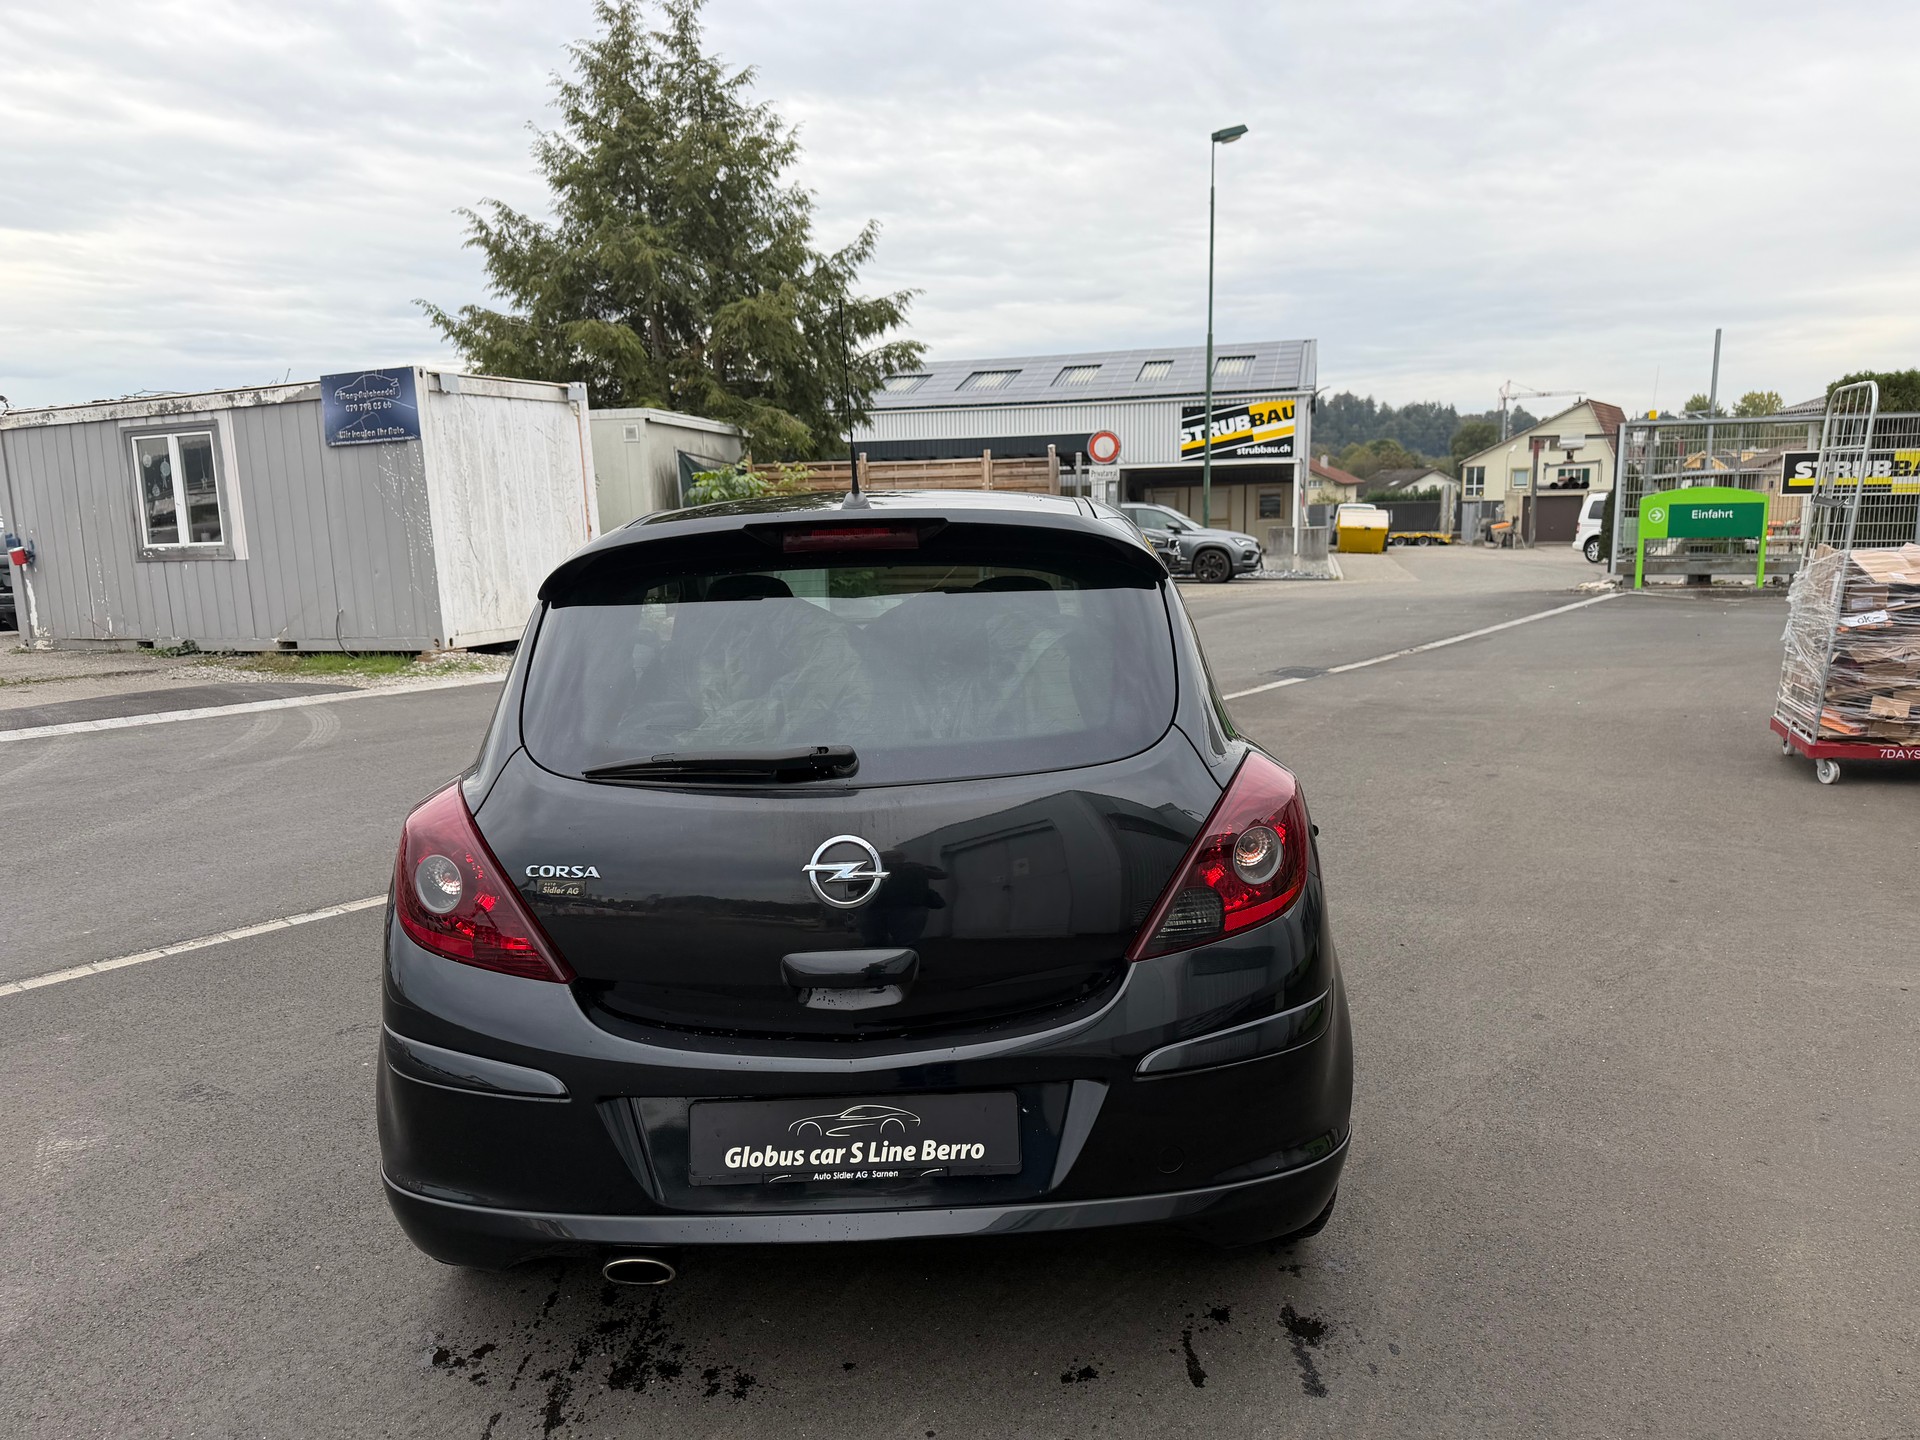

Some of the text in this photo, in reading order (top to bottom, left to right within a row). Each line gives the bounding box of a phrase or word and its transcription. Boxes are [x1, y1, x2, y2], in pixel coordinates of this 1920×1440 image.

[345, 404, 358, 412] 079
[373, 401, 382, 410] 05
[1181, 405, 1295, 444] STRUBBAU
[339, 426, 405, 439] Wir kaufen Ihr Auto
[1236, 443, 1291, 456] strubbau.ch
[1691, 508, 1734, 519] Einfahrt
[1879, 748, 1920, 760] 7DAYS
[525, 864, 601, 879] CORSA
[542, 886, 580, 895] Sidler AG
[724, 1139, 985, 1169] Globus car S Line Berro
[813, 1170, 899, 1180] Auto Sidler AG Sarnen
